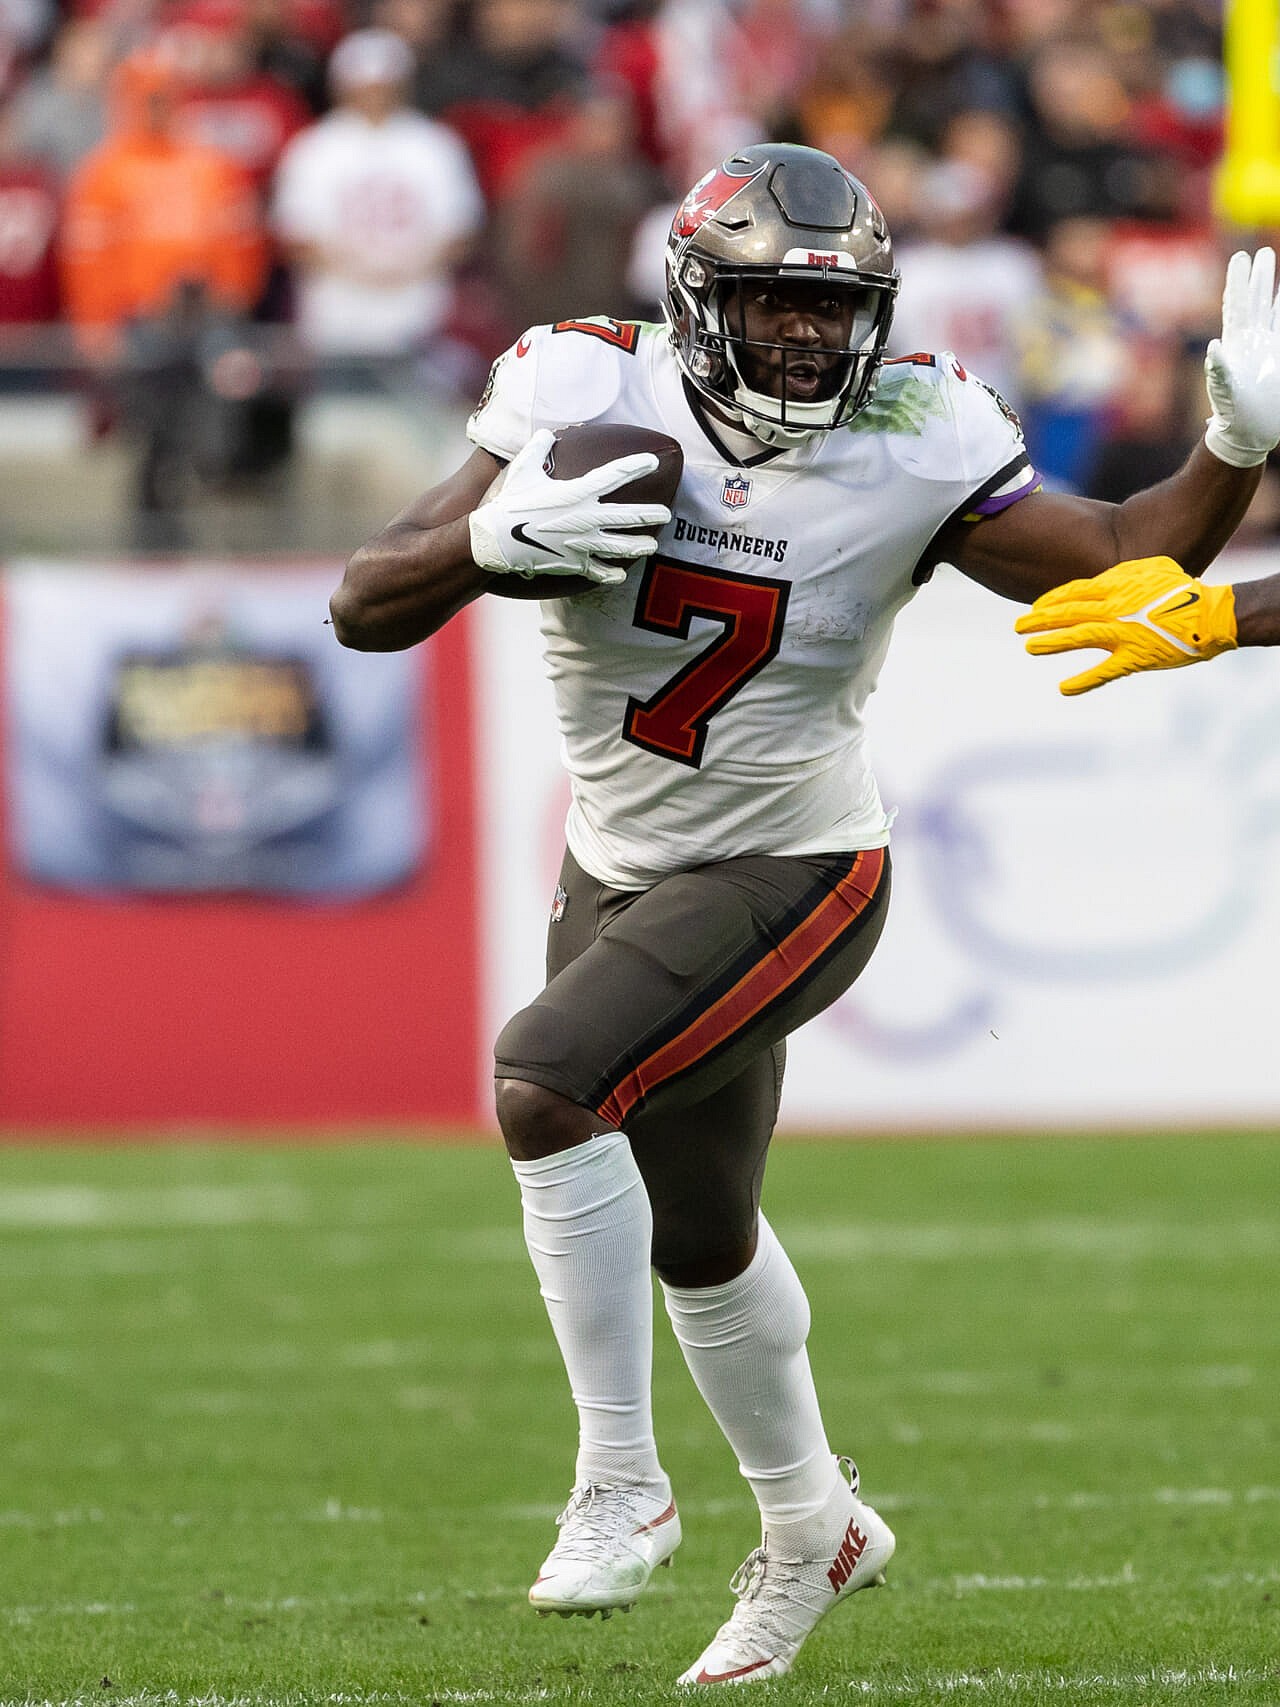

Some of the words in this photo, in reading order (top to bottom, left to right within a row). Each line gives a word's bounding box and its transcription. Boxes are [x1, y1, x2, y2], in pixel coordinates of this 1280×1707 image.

[725, 488, 747, 504] NFL
[673, 516, 788, 563] BUCCANEERS
[621, 553, 793, 770] 7
[826, 1516, 868, 1596] NIKE
